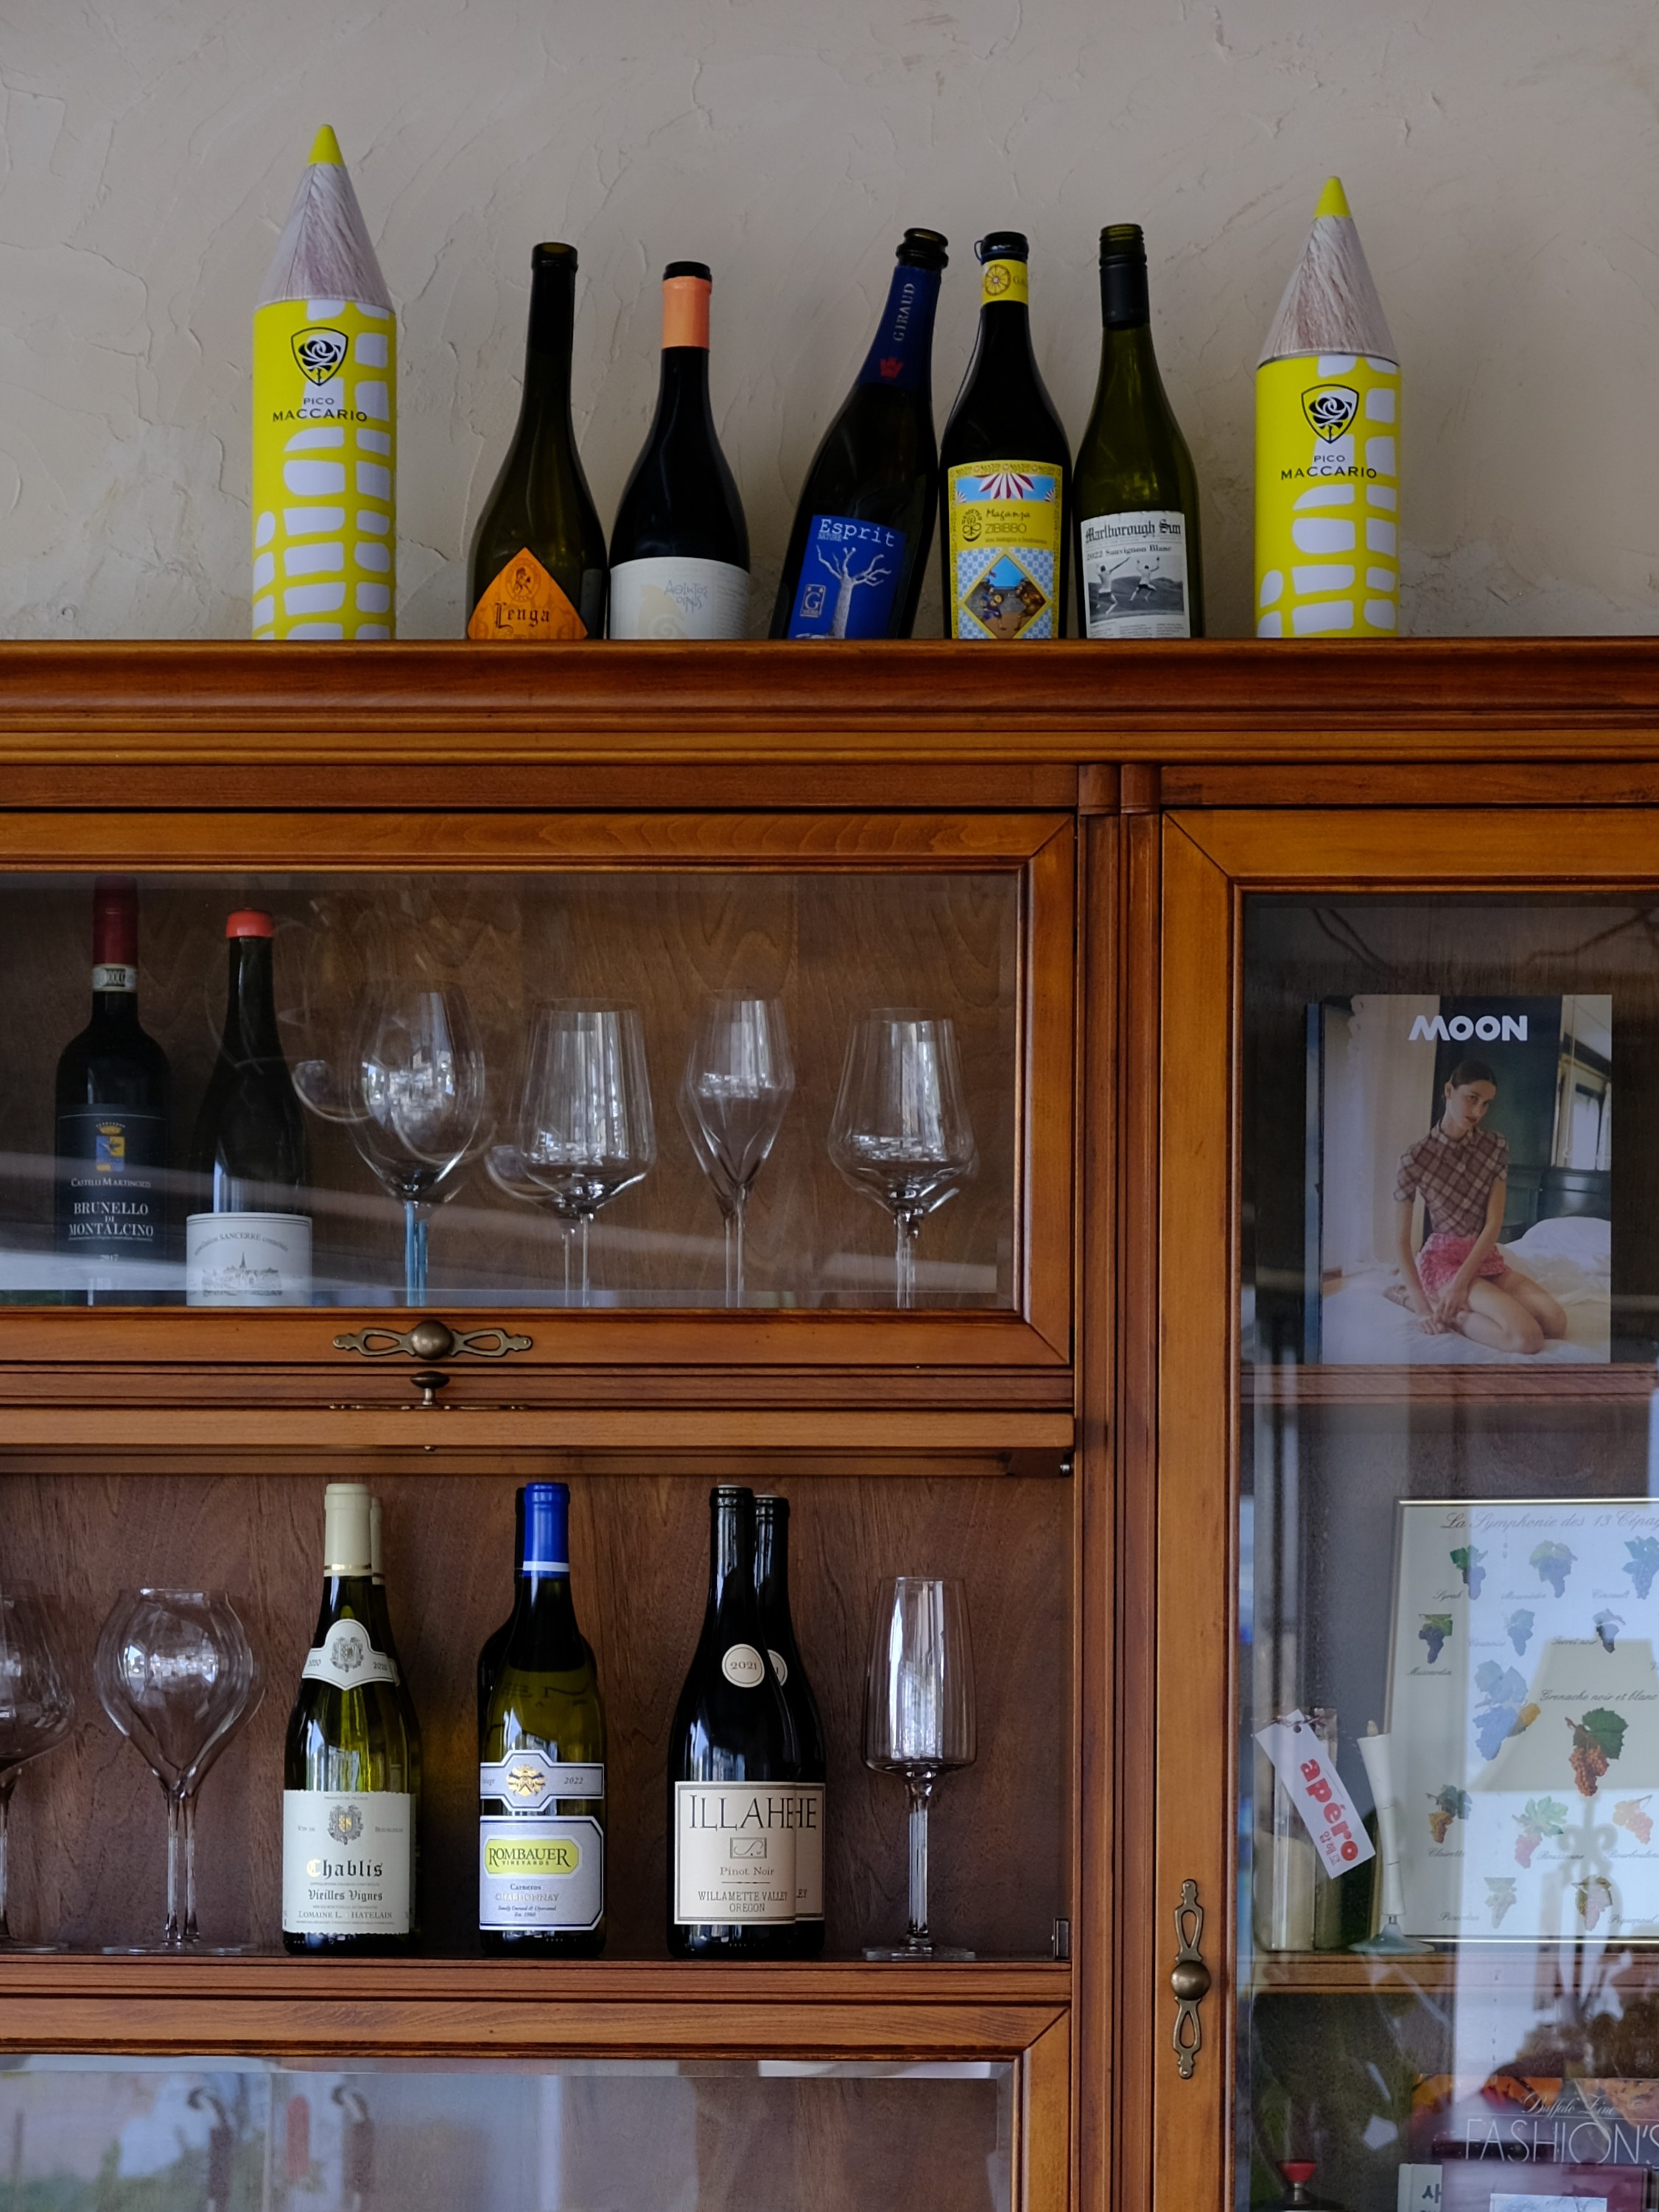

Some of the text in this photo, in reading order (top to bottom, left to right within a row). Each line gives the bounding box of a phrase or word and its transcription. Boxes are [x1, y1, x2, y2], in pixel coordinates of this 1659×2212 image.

[893, 283, 915, 341] GIRAUD
[303, 397, 335, 405] PICO
[272, 407, 368, 423] MACCARIO
[1313, 455, 1346, 463] PICO
[1280, 466, 1378, 480] MACCARIO
[819, 518, 895, 547] Esprit
[985, 522, 1027, 534] ZIBIBBO
[1085, 520, 1155, 543] Marlborough
[1159, 518, 1181, 534] Sun
[1106, 546, 1147, 555] Sauvignon
[1149, 544, 1172, 552] Blanc
[494, 602, 550, 634] Lenga
[1408, 1015, 1528, 1041] MOON
[74, 1202, 149, 1216] BRUNELLO
[69, 1222, 154, 1236] MONTALCINO
[220, 1231, 262, 1240] SANCERRE
[1440, 1512, 1467, 1529] La
[1469, 1511, 1557, 1533] Symphonie
[1560, 1513, 1585, 1527] des
[730, 1661, 757, 1670] 2021
[1540, 1689, 1589, 1701] Grenache
[564, 1777, 584, 1785] 2022
[690, 1794, 794, 1831] ILLAHE
[1300, 1758, 1358, 1862] apéro
[488, 1847, 572, 1867] ROMBAUER
[1428, 1848, 1465, 1857] Clairett
[306, 1858, 384, 1880] Chablis
[719, 1866, 775, 1876] Pinot Noir
[510, 1883, 541, 1891] Carneros
[308, 1889, 384, 1903] Vieilles Vignes
[698, 1891, 788, 1901] WILLAMETTE VALLEY
[347, 1911, 393, 1919] HATELAIN
[729, 1903, 765, 1913] OREGON
